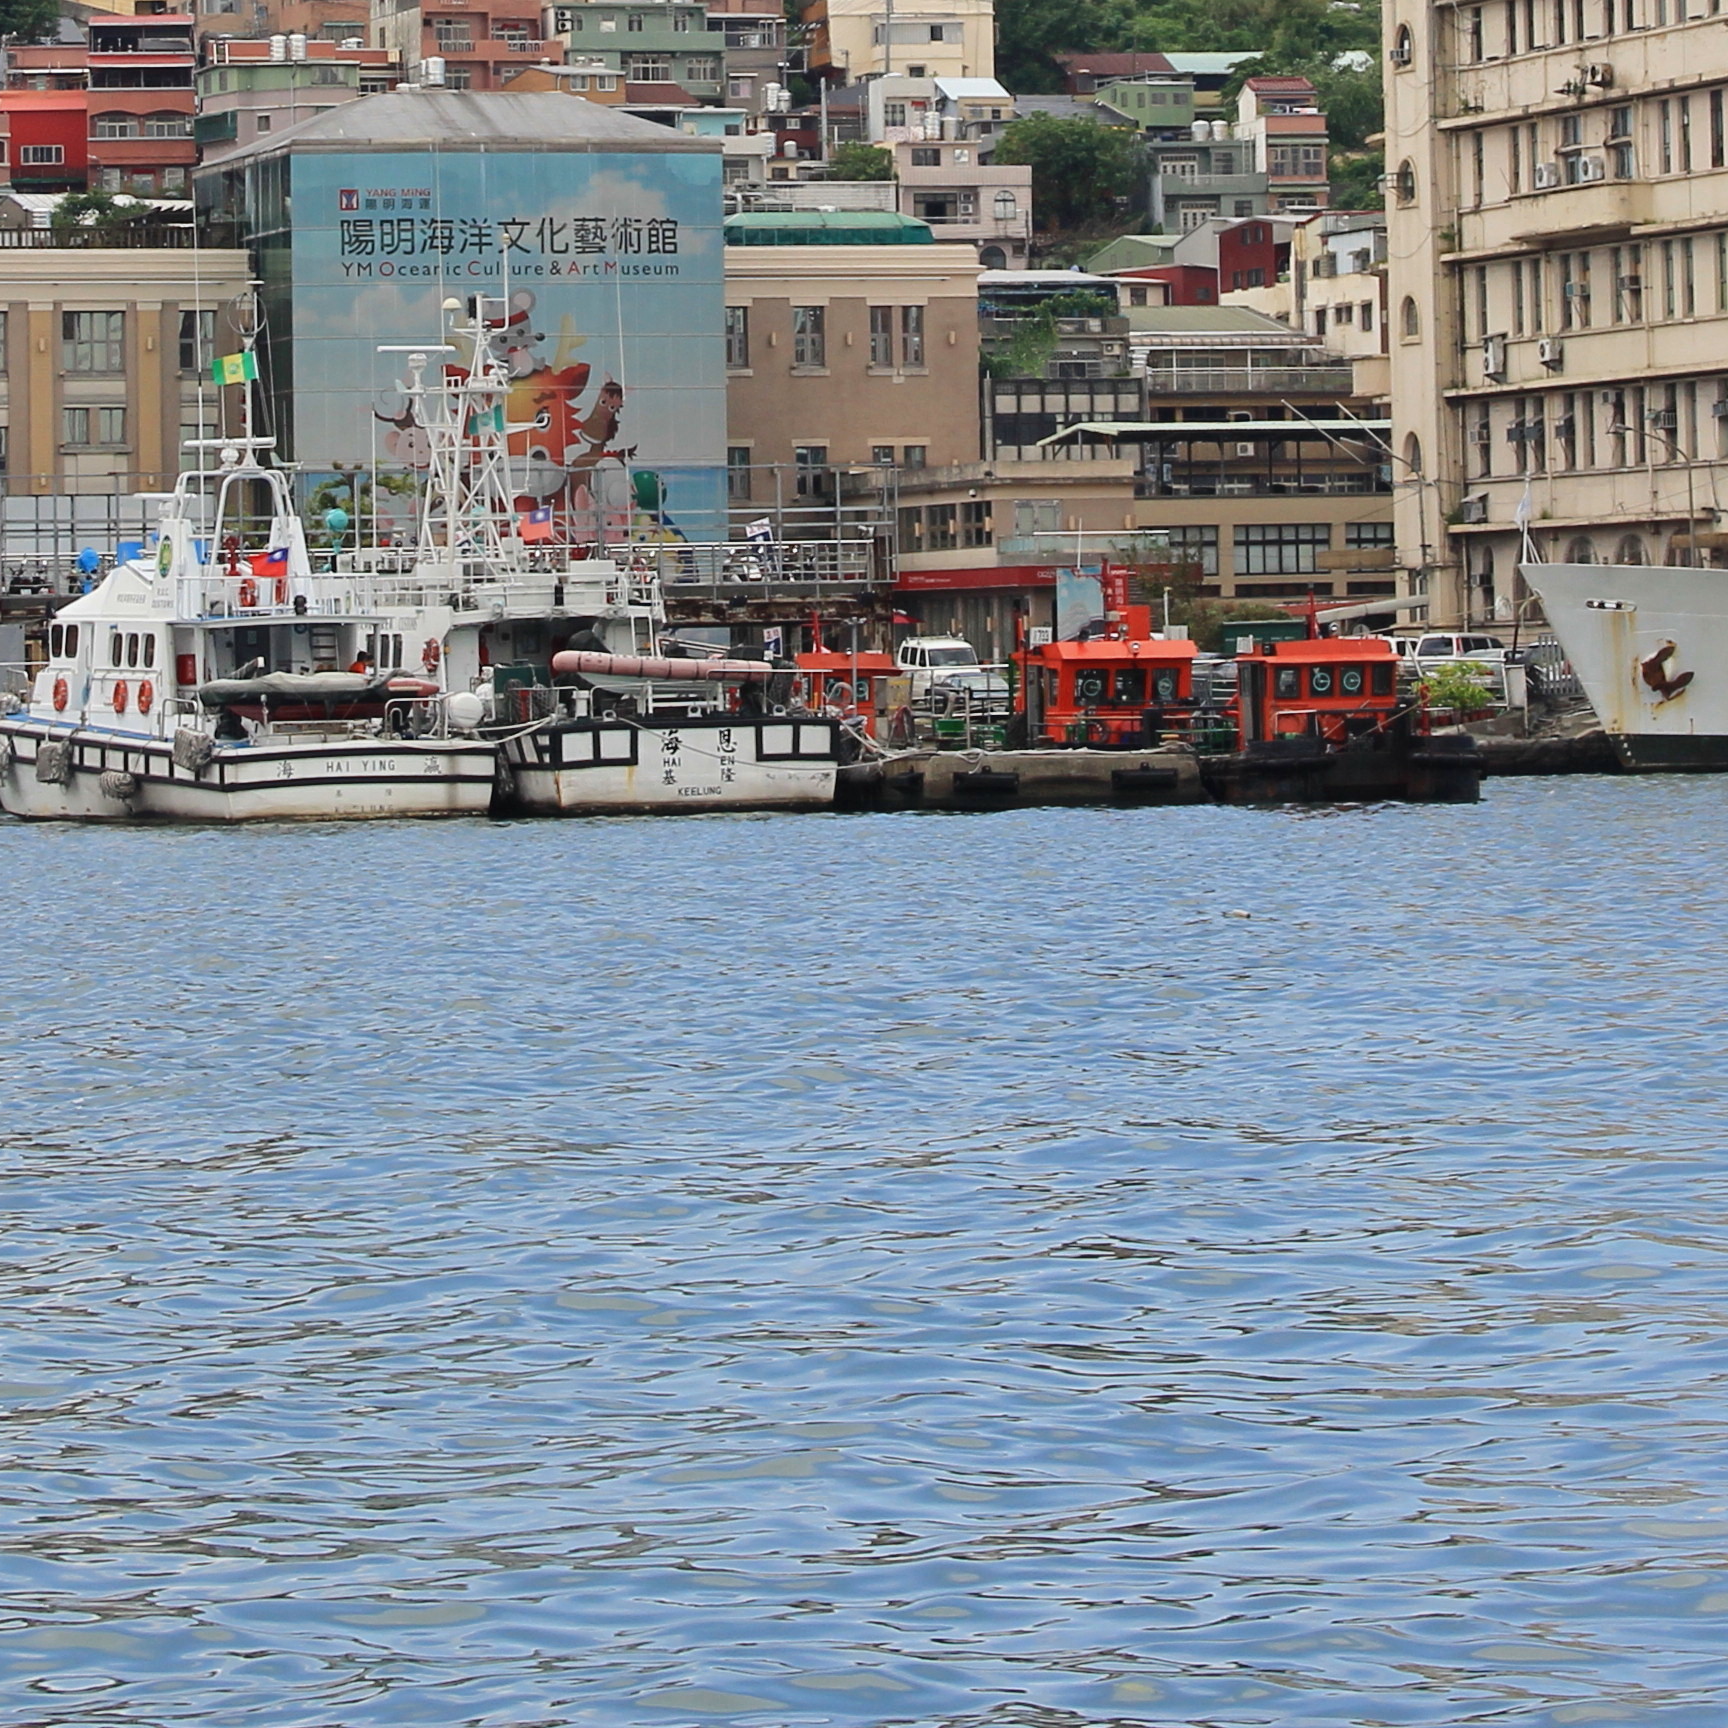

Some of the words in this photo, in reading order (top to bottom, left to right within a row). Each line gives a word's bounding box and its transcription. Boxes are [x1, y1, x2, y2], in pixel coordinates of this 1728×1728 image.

[365, 188, 397, 198] YANG
[401, 187, 431, 198] MING
[339, 218, 679, 256] 陽明海洋文化藝術館
[342, 262, 372, 277] YM
[549, 261, 563, 276] &
[567, 260, 600, 276] Art
[604, 260, 680, 276] Museum
[326, 760, 351, 773] HAI
[362, 759, 396, 772] YING
[663, 757, 681, 768] HAI
[720, 756, 735, 766] EN
[678, 786, 722, 797] KEELUNG
